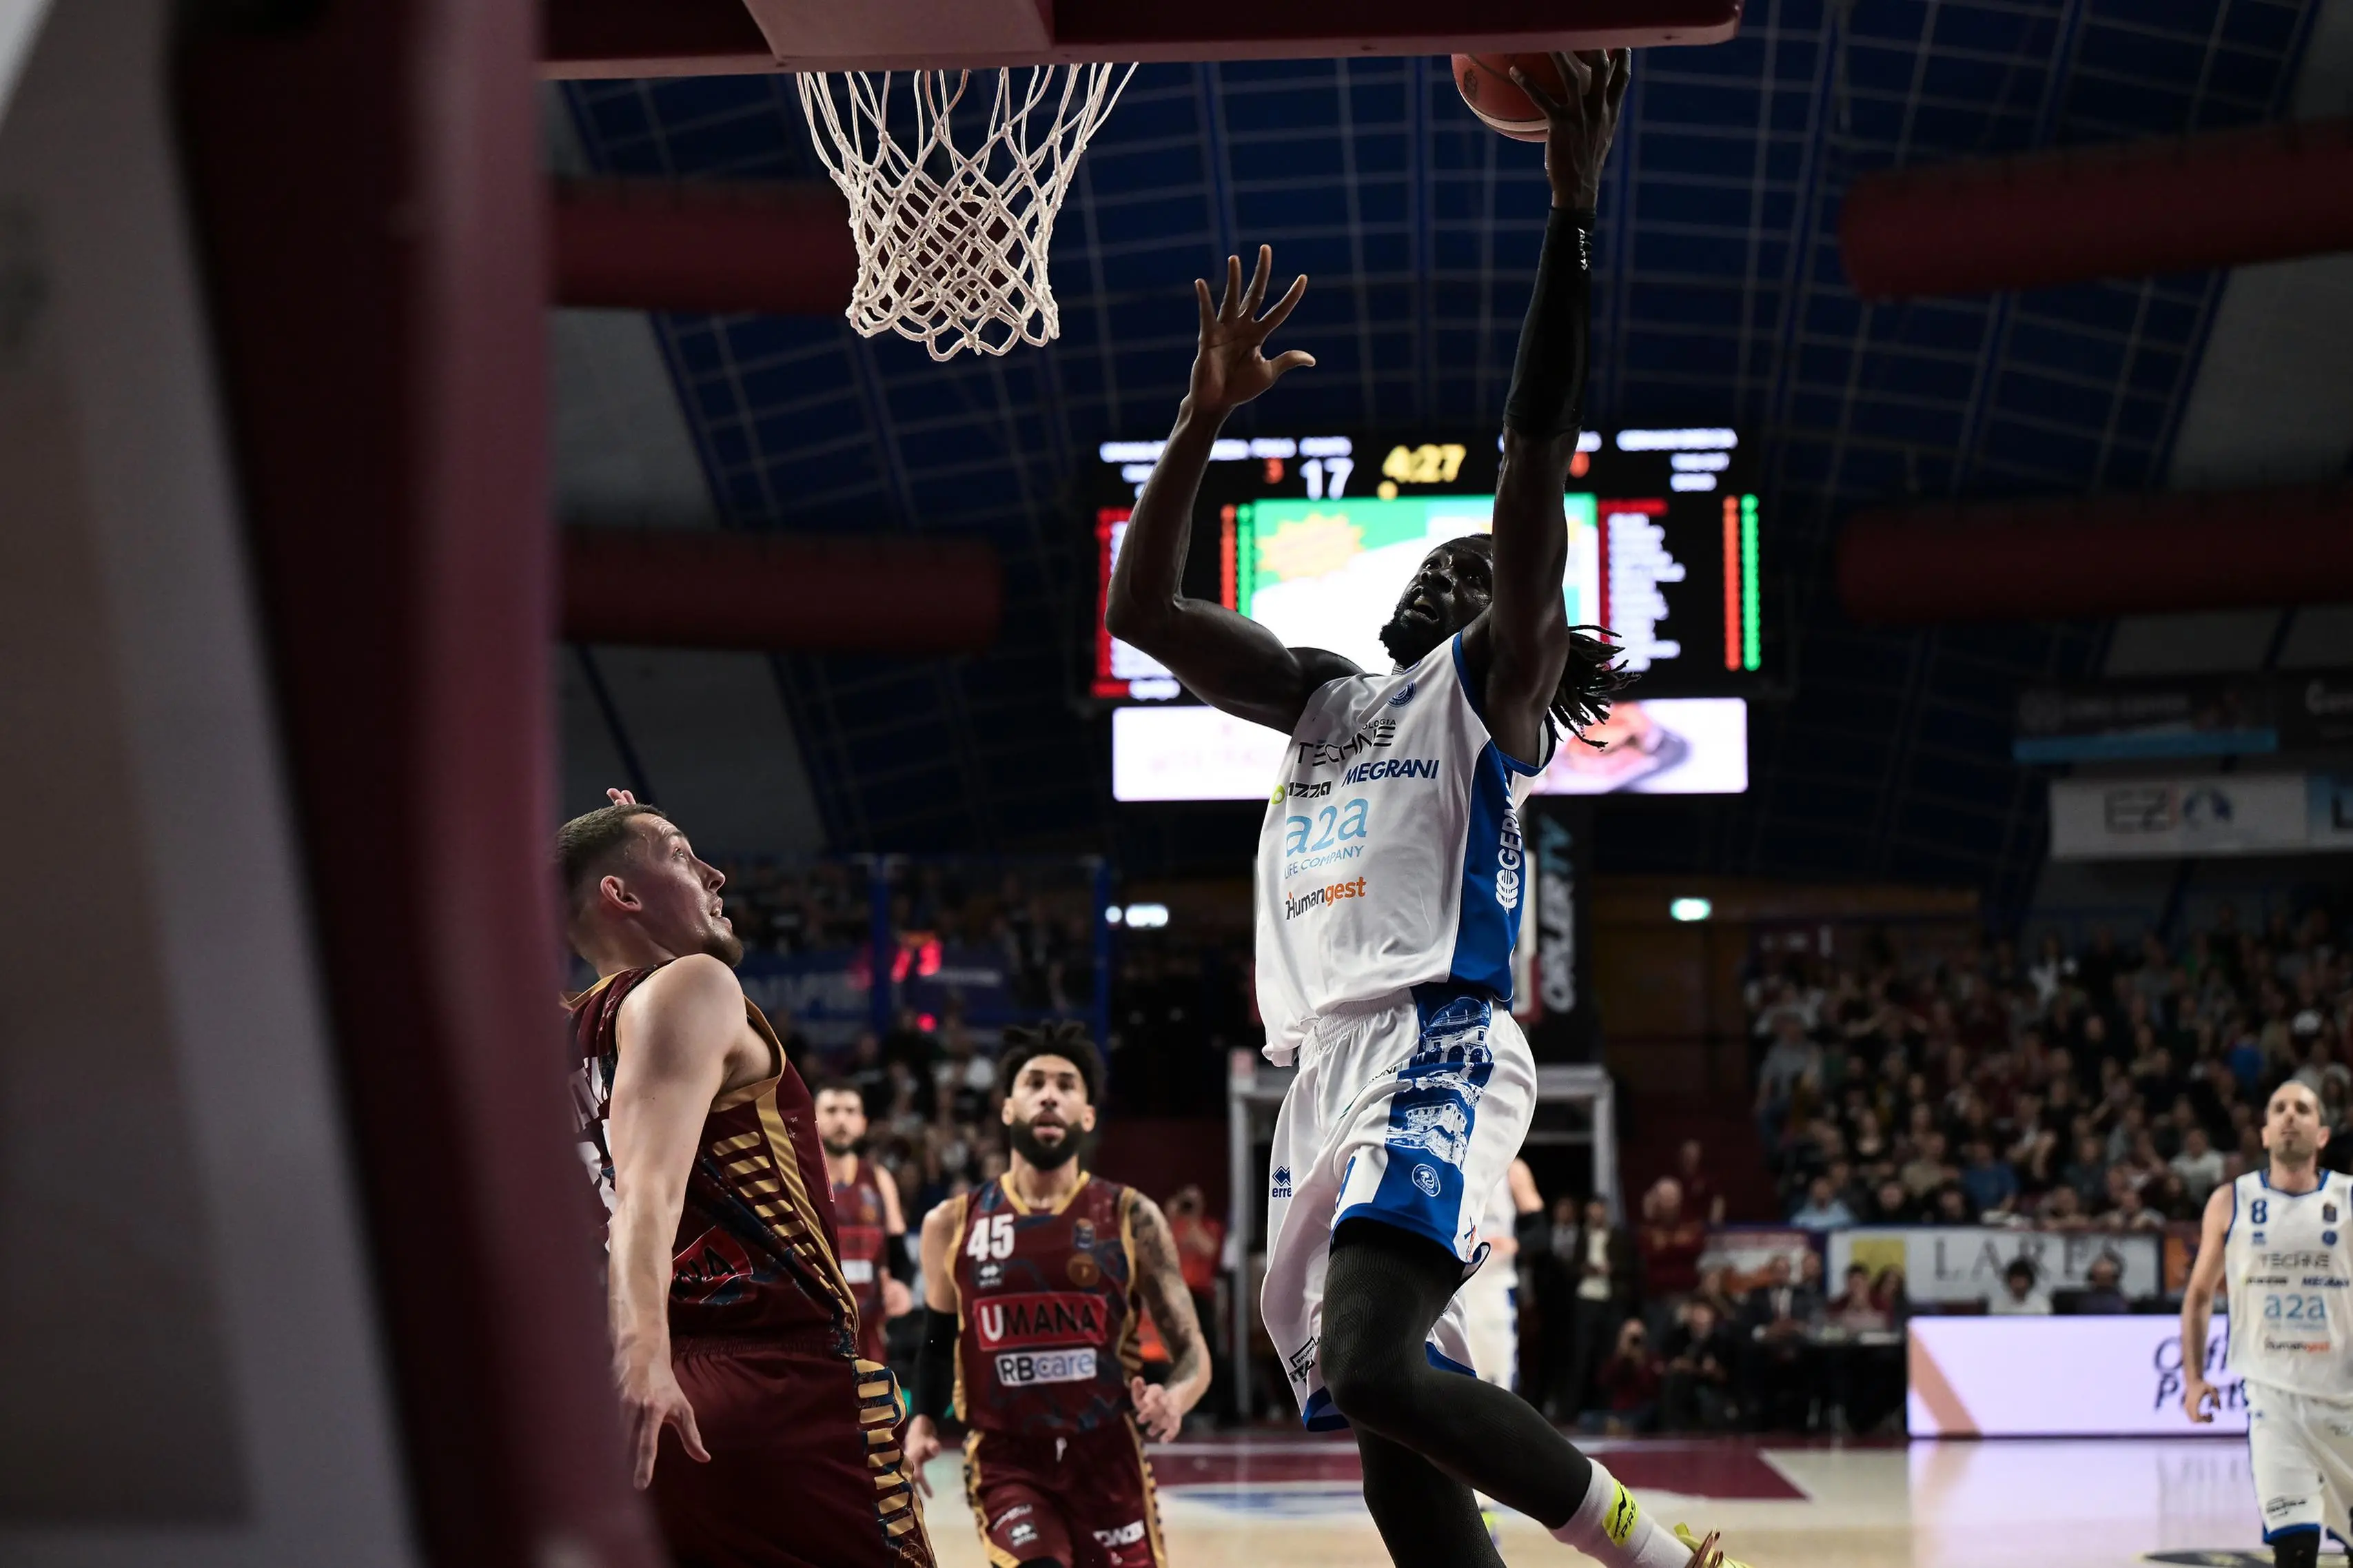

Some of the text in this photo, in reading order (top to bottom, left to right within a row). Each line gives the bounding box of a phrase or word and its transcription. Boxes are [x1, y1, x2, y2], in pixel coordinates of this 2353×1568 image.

[1300, 457, 1354, 501] 17
[1383, 445, 1466, 482] 4:27
[1298, 725, 1396, 766] TECHNE
[1342, 759, 1440, 787] MEGRANI
[1286, 798, 1369, 857] a2a
[1285, 845, 1364, 879] LIFE COMPANY
[1286, 877, 1367, 920] Humangest
[1272, 1187, 1292, 1198] erre
[2251, 1200, 2267, 1223] 8
[967, 1214, 1015, 1262] 45
[981, 1303, 1098, 1343] UMANA
[2264, 1294, 2325, 1319] a2a
[1000, 1353, 1094, 1382] RBcare
